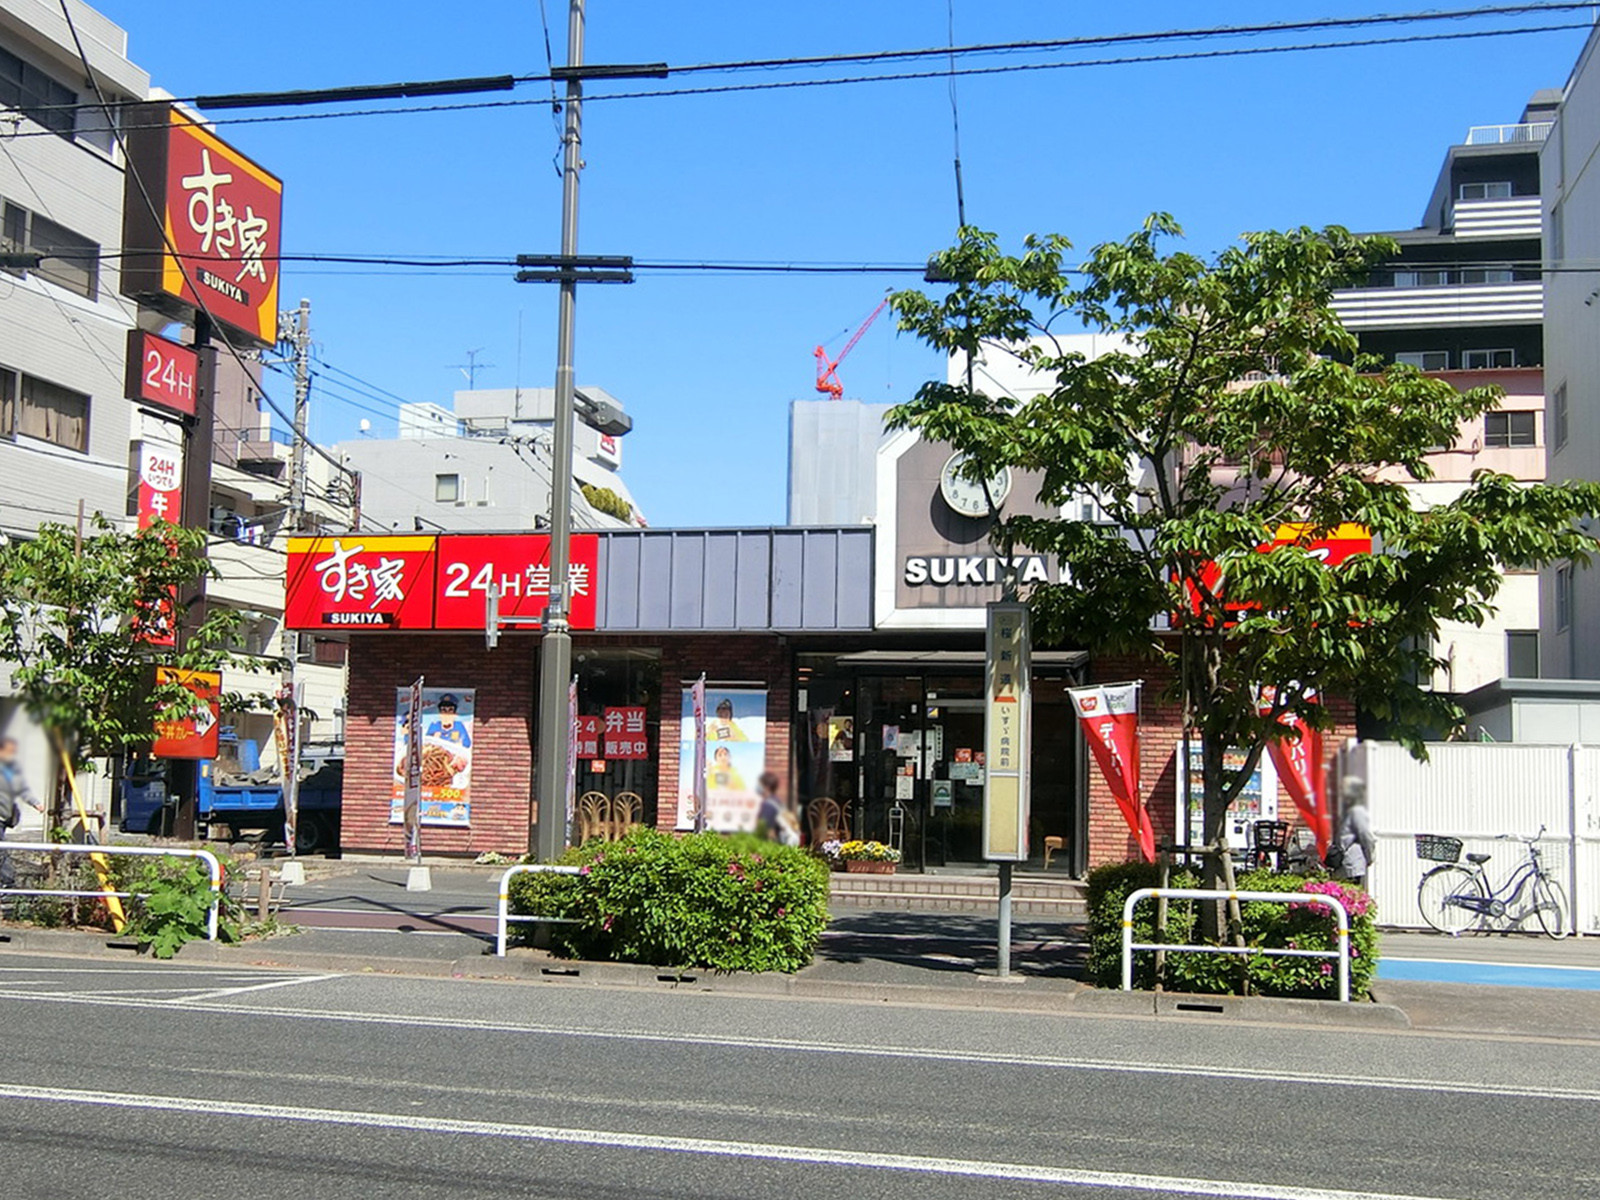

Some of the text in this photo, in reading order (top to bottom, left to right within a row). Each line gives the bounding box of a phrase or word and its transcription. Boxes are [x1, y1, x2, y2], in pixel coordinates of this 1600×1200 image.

[181, 148, 268, 283] すき家
[203, 271, 243, 302] SUKIYA
[146, 350, 193, 400] 24H
[149, 455, 175, 476] 24H
[314, 538, 406, 610] すき家
[330, 612, 384, 625] SUKIYA
[606, 711, 645, 733] 弁当
[605, 741, 647, 755] 販売中
